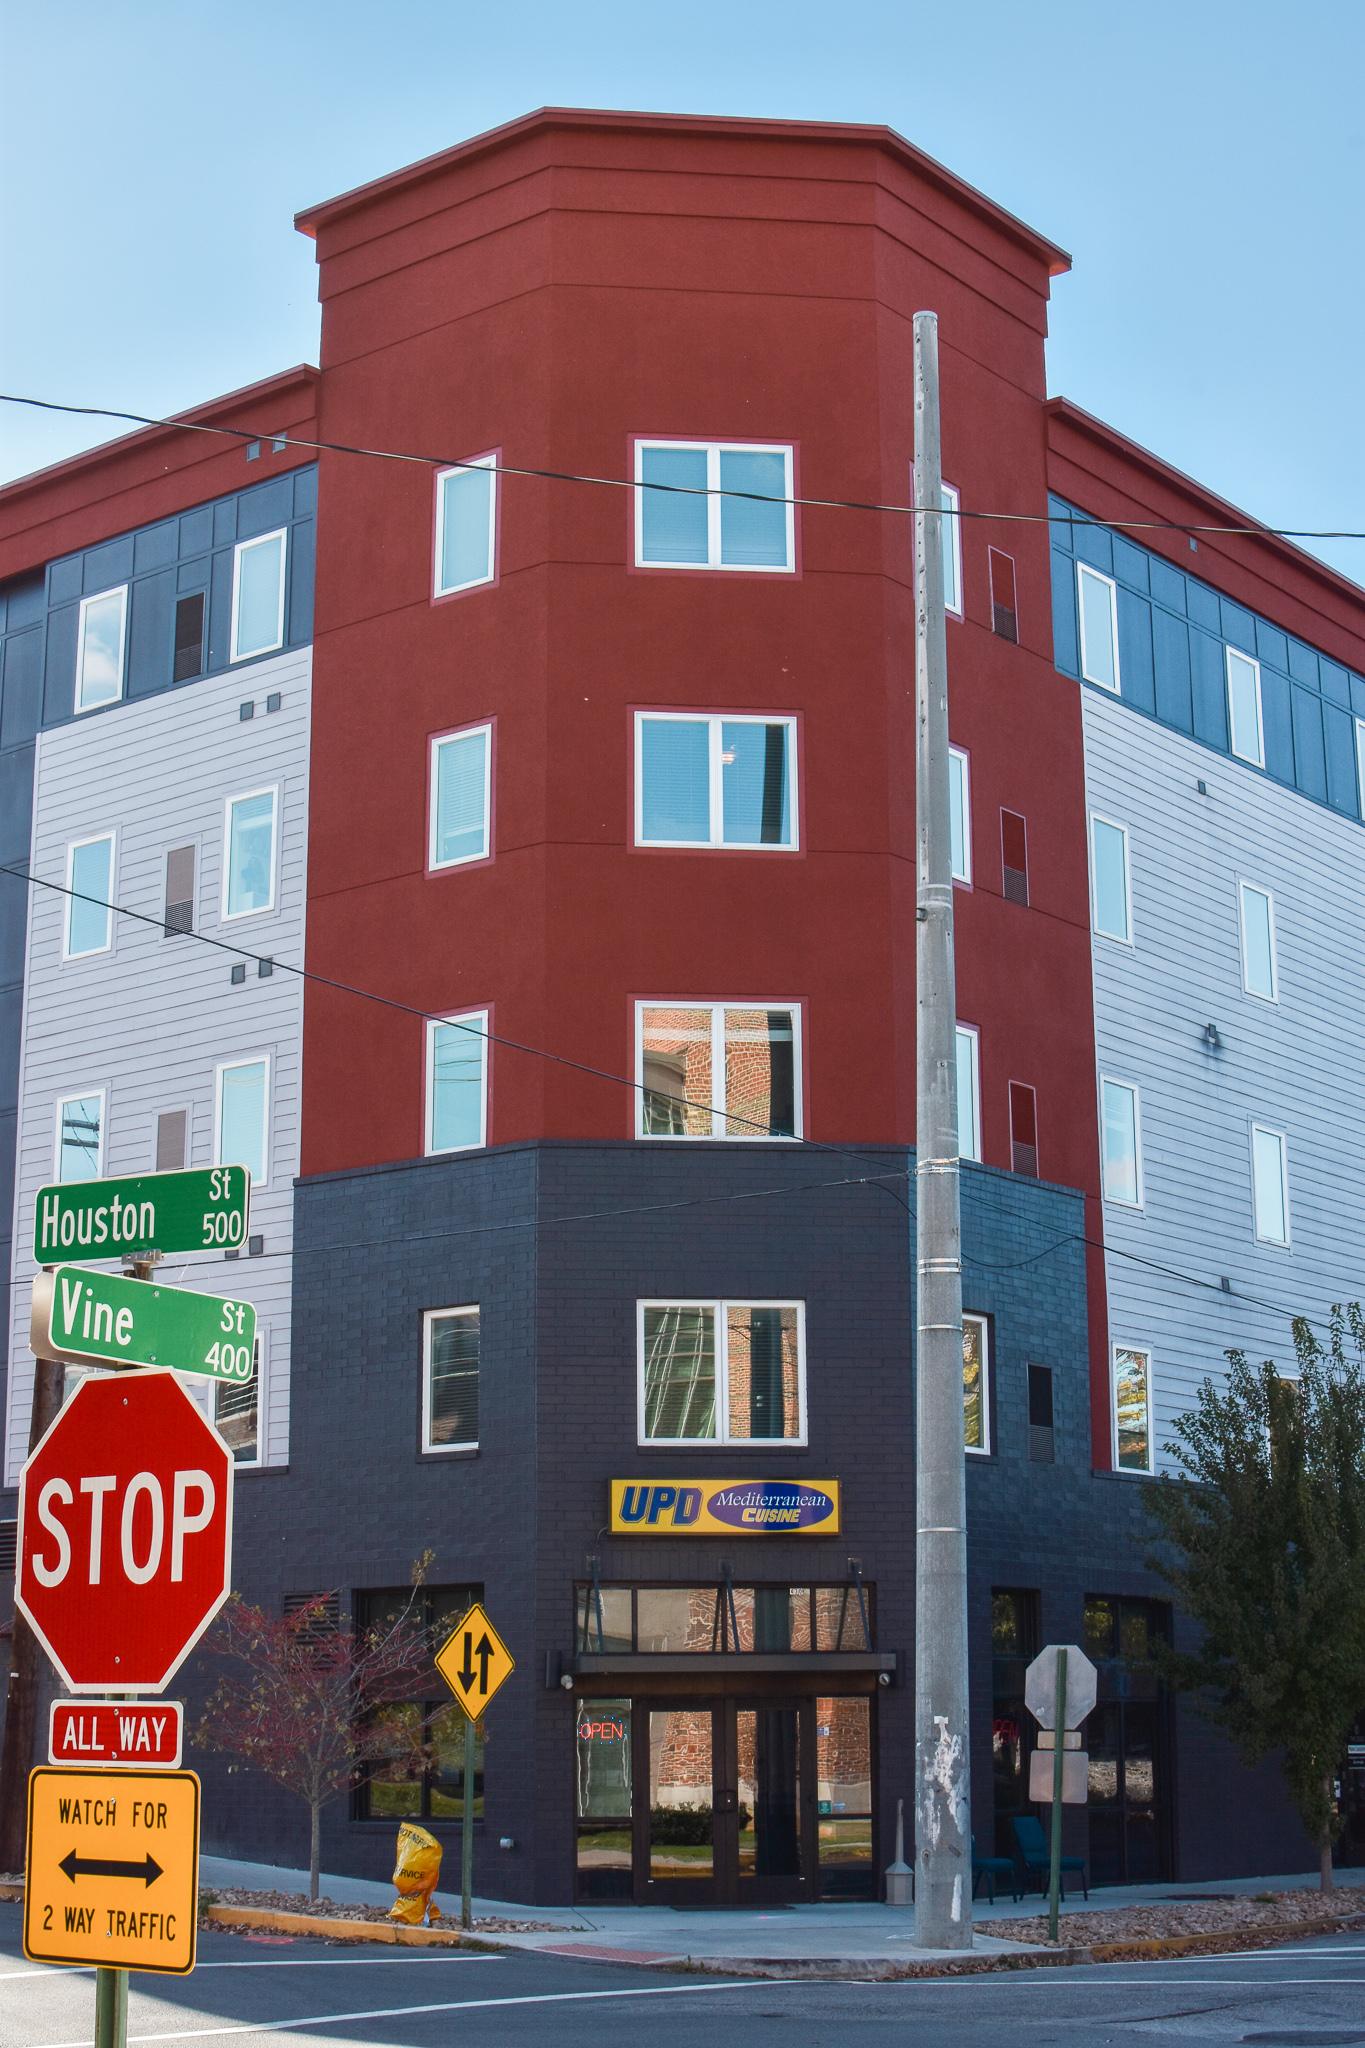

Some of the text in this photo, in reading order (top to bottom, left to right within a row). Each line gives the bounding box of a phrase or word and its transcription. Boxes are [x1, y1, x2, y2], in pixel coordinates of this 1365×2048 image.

[41, 1169, 231, 1248] Houston St
[202, 1210, 241, 1245] 500
[61, 1278, 245, 1346] Vine St
[205, 1341, 250, 1378] 400
[619, 1486, 704, 1526] UPD
[716, 1491, 826, 1506] Mediterranean
[742, 1508, 801, 1522] CUISINE
[32, 1469, 216, 1588] STOP
[62, 1716, 167, 1752] ALL WAY
[580, 1722, 623, 1739] OPEN
[993, 1719, 1020, 1744] PEN
[59, 1798, 168, 1829] WATCH FOR
[43, 1904, 177, 1942] 2 WAY TRAFFIC
